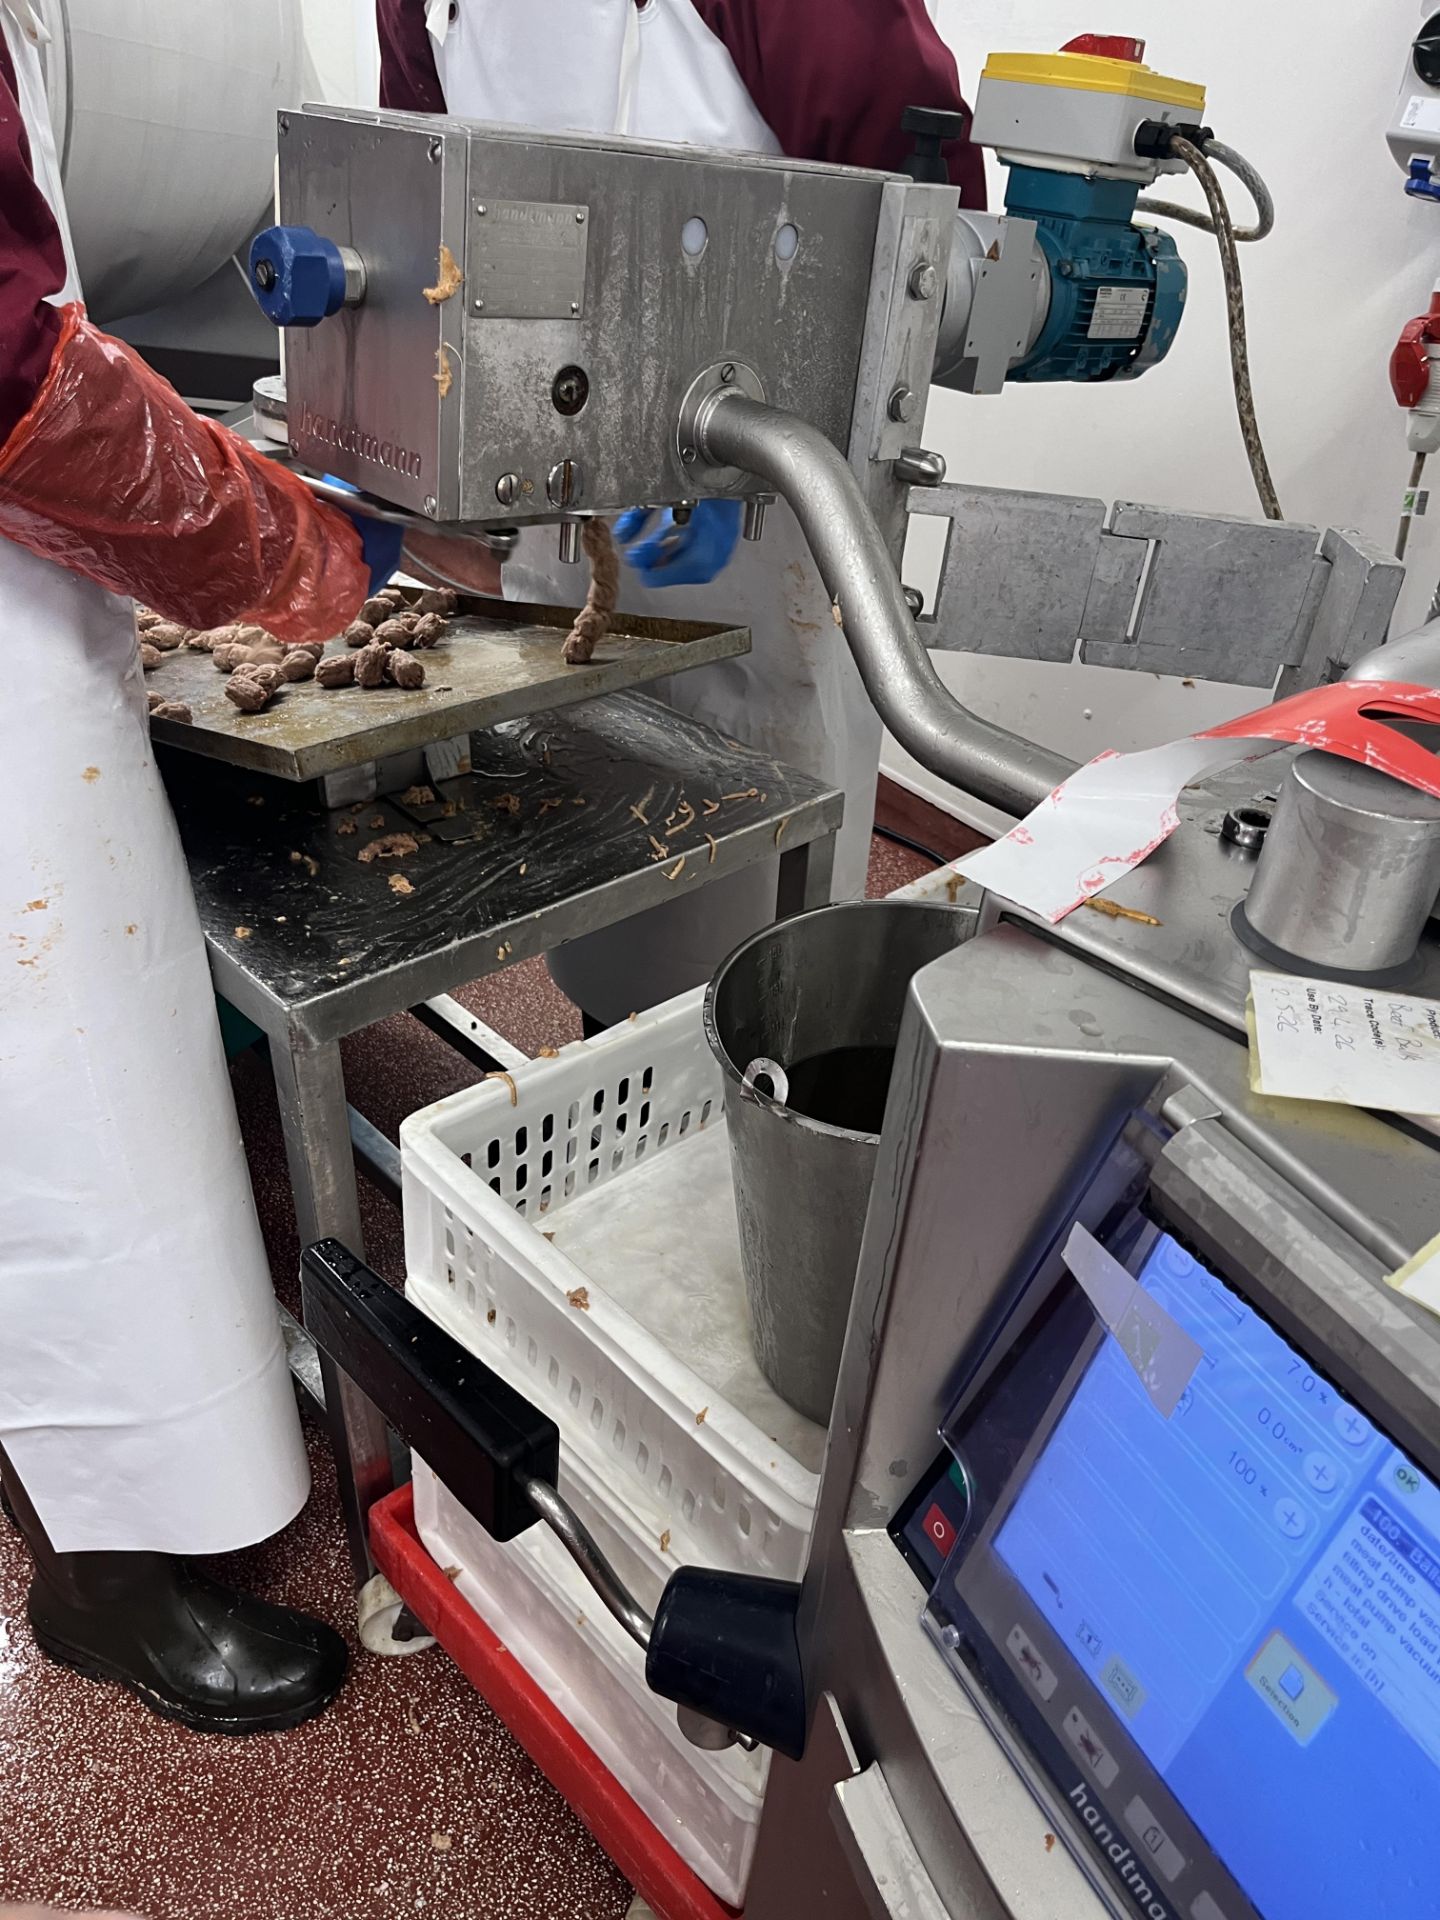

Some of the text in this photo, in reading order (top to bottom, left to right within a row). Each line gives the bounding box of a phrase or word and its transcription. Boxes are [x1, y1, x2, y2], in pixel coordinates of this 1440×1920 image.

[300, 400, 422, 480] handtmann
[1306, 987, 1324, 1035] Use By Date:
[1363, 998, 1386, 1051] Trace Code(s):
[1287, 1359, 1316, 1393] 7.0
[1227, 1450, 1257, 1485] 100
[1395, 1467, 1418, 1491] OK
[1351, 1538, 1382, 1572] meat
[1380, 1571, 1416, 1609] pump
[1360, 1524, 1416, 1585] date/time
[1314, 1588, 1378, 1662] Service on
[1323, 1575, 1334, 1591] h
[1342, 1598, 1371, 1630] total
[1332, 1563, 1363, 1598] meat
[1362, 1598, 1397, 1636] pump
[1342, 1550, 1439, 1655] filling drive load
[1305, 1601, 1350, 1654] Service
[1259, 1674, 1300, 1728] Selection
